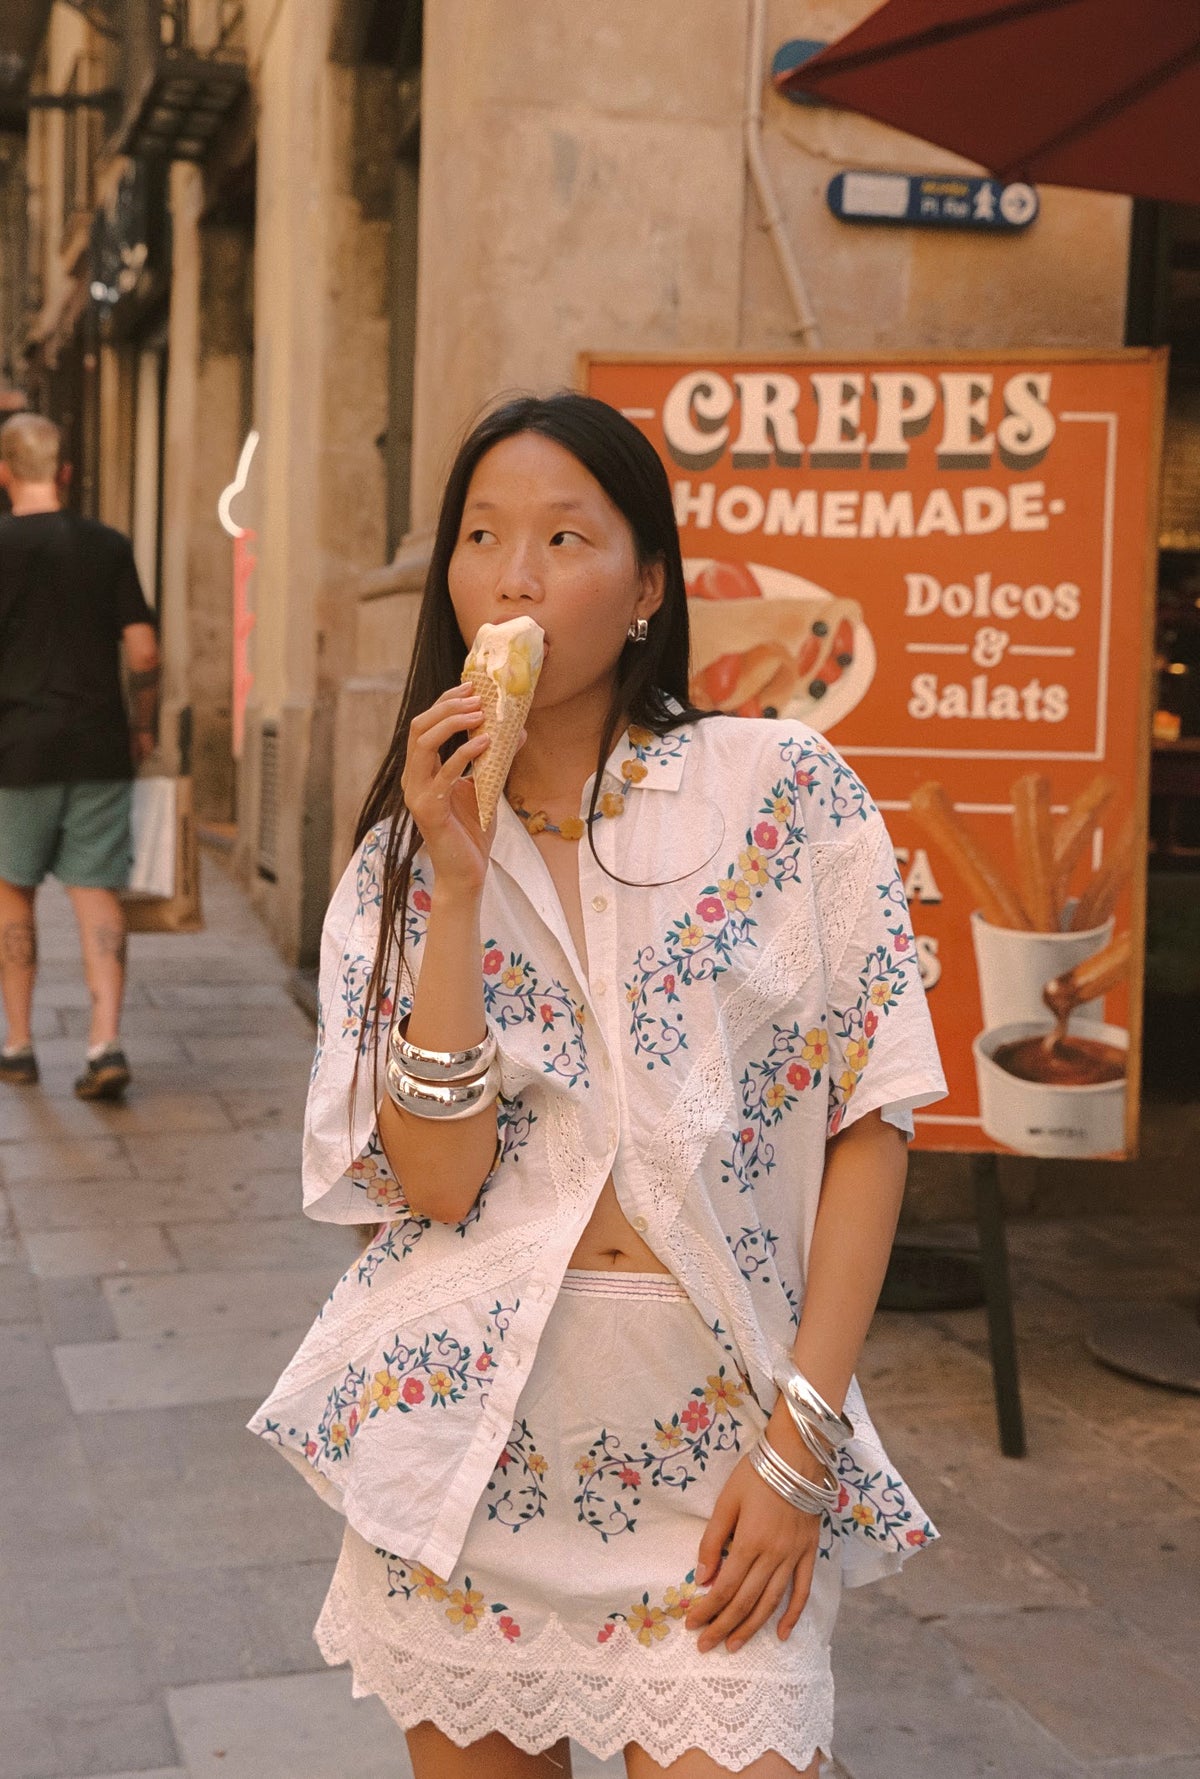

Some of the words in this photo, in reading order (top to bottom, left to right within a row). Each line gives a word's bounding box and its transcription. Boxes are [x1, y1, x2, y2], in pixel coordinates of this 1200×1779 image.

[662, 370, 1056, 466] CREPES
[904, 572, 1081, 621] Dolcos
[972, 626, 1009, 668] &
[908, 673, 1069, 723] Salats
